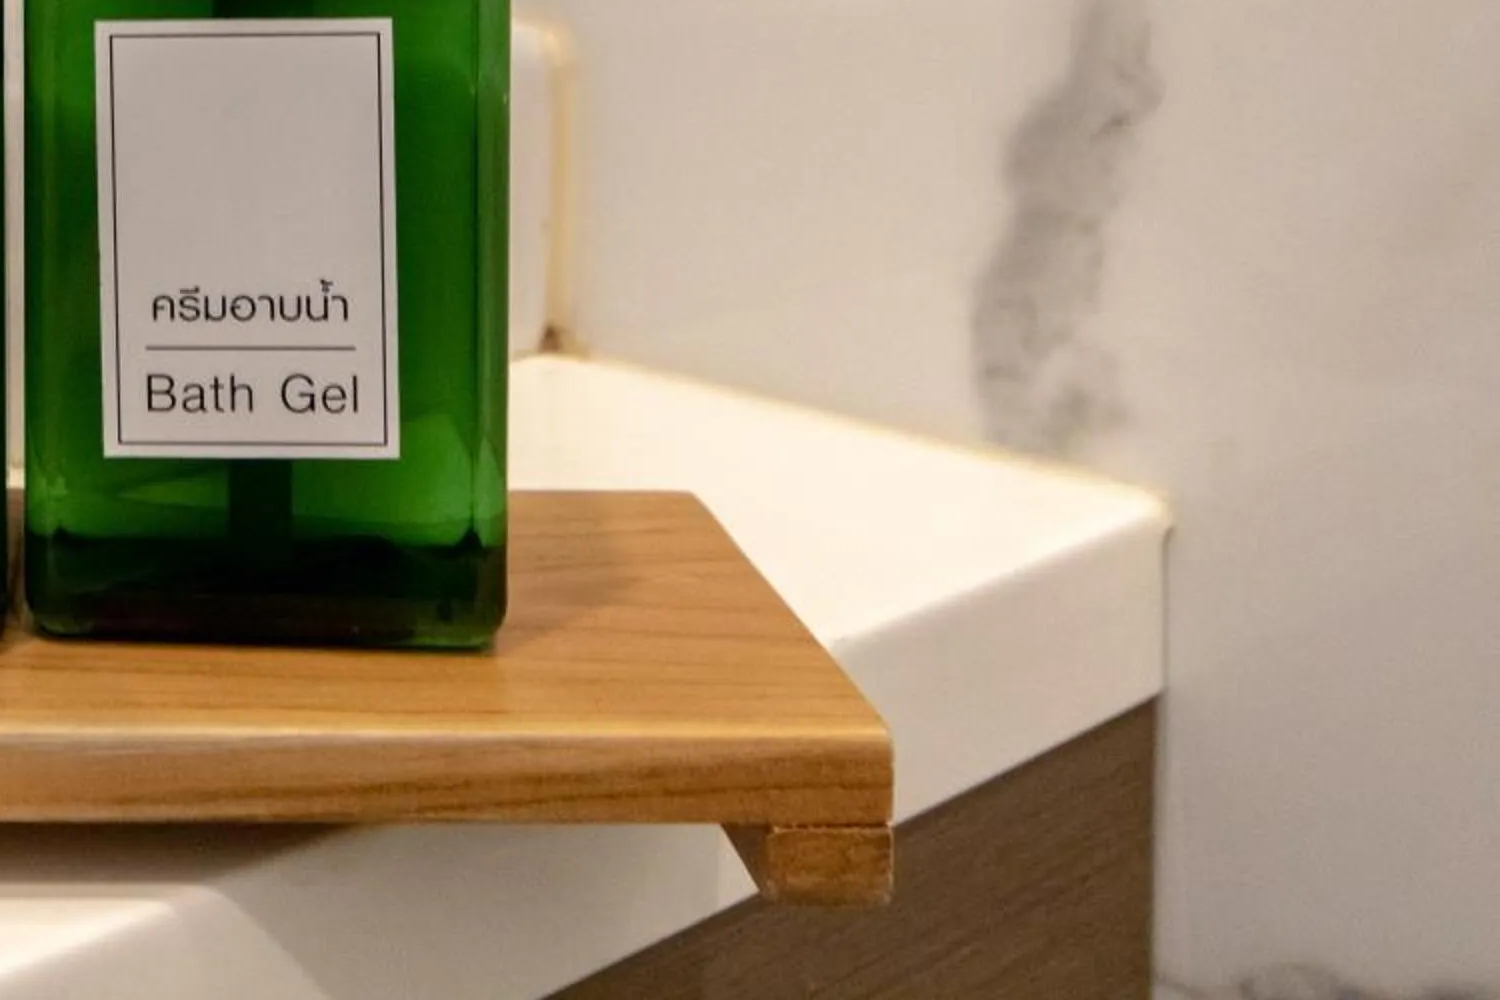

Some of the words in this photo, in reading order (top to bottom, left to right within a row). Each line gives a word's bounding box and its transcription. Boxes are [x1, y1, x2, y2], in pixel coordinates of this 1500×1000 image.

[151, 279, 349, 323] ครีมอาบน้ำ
[146, 373, 254, 414] Bath
[281, 373, 359, 414] Gel
